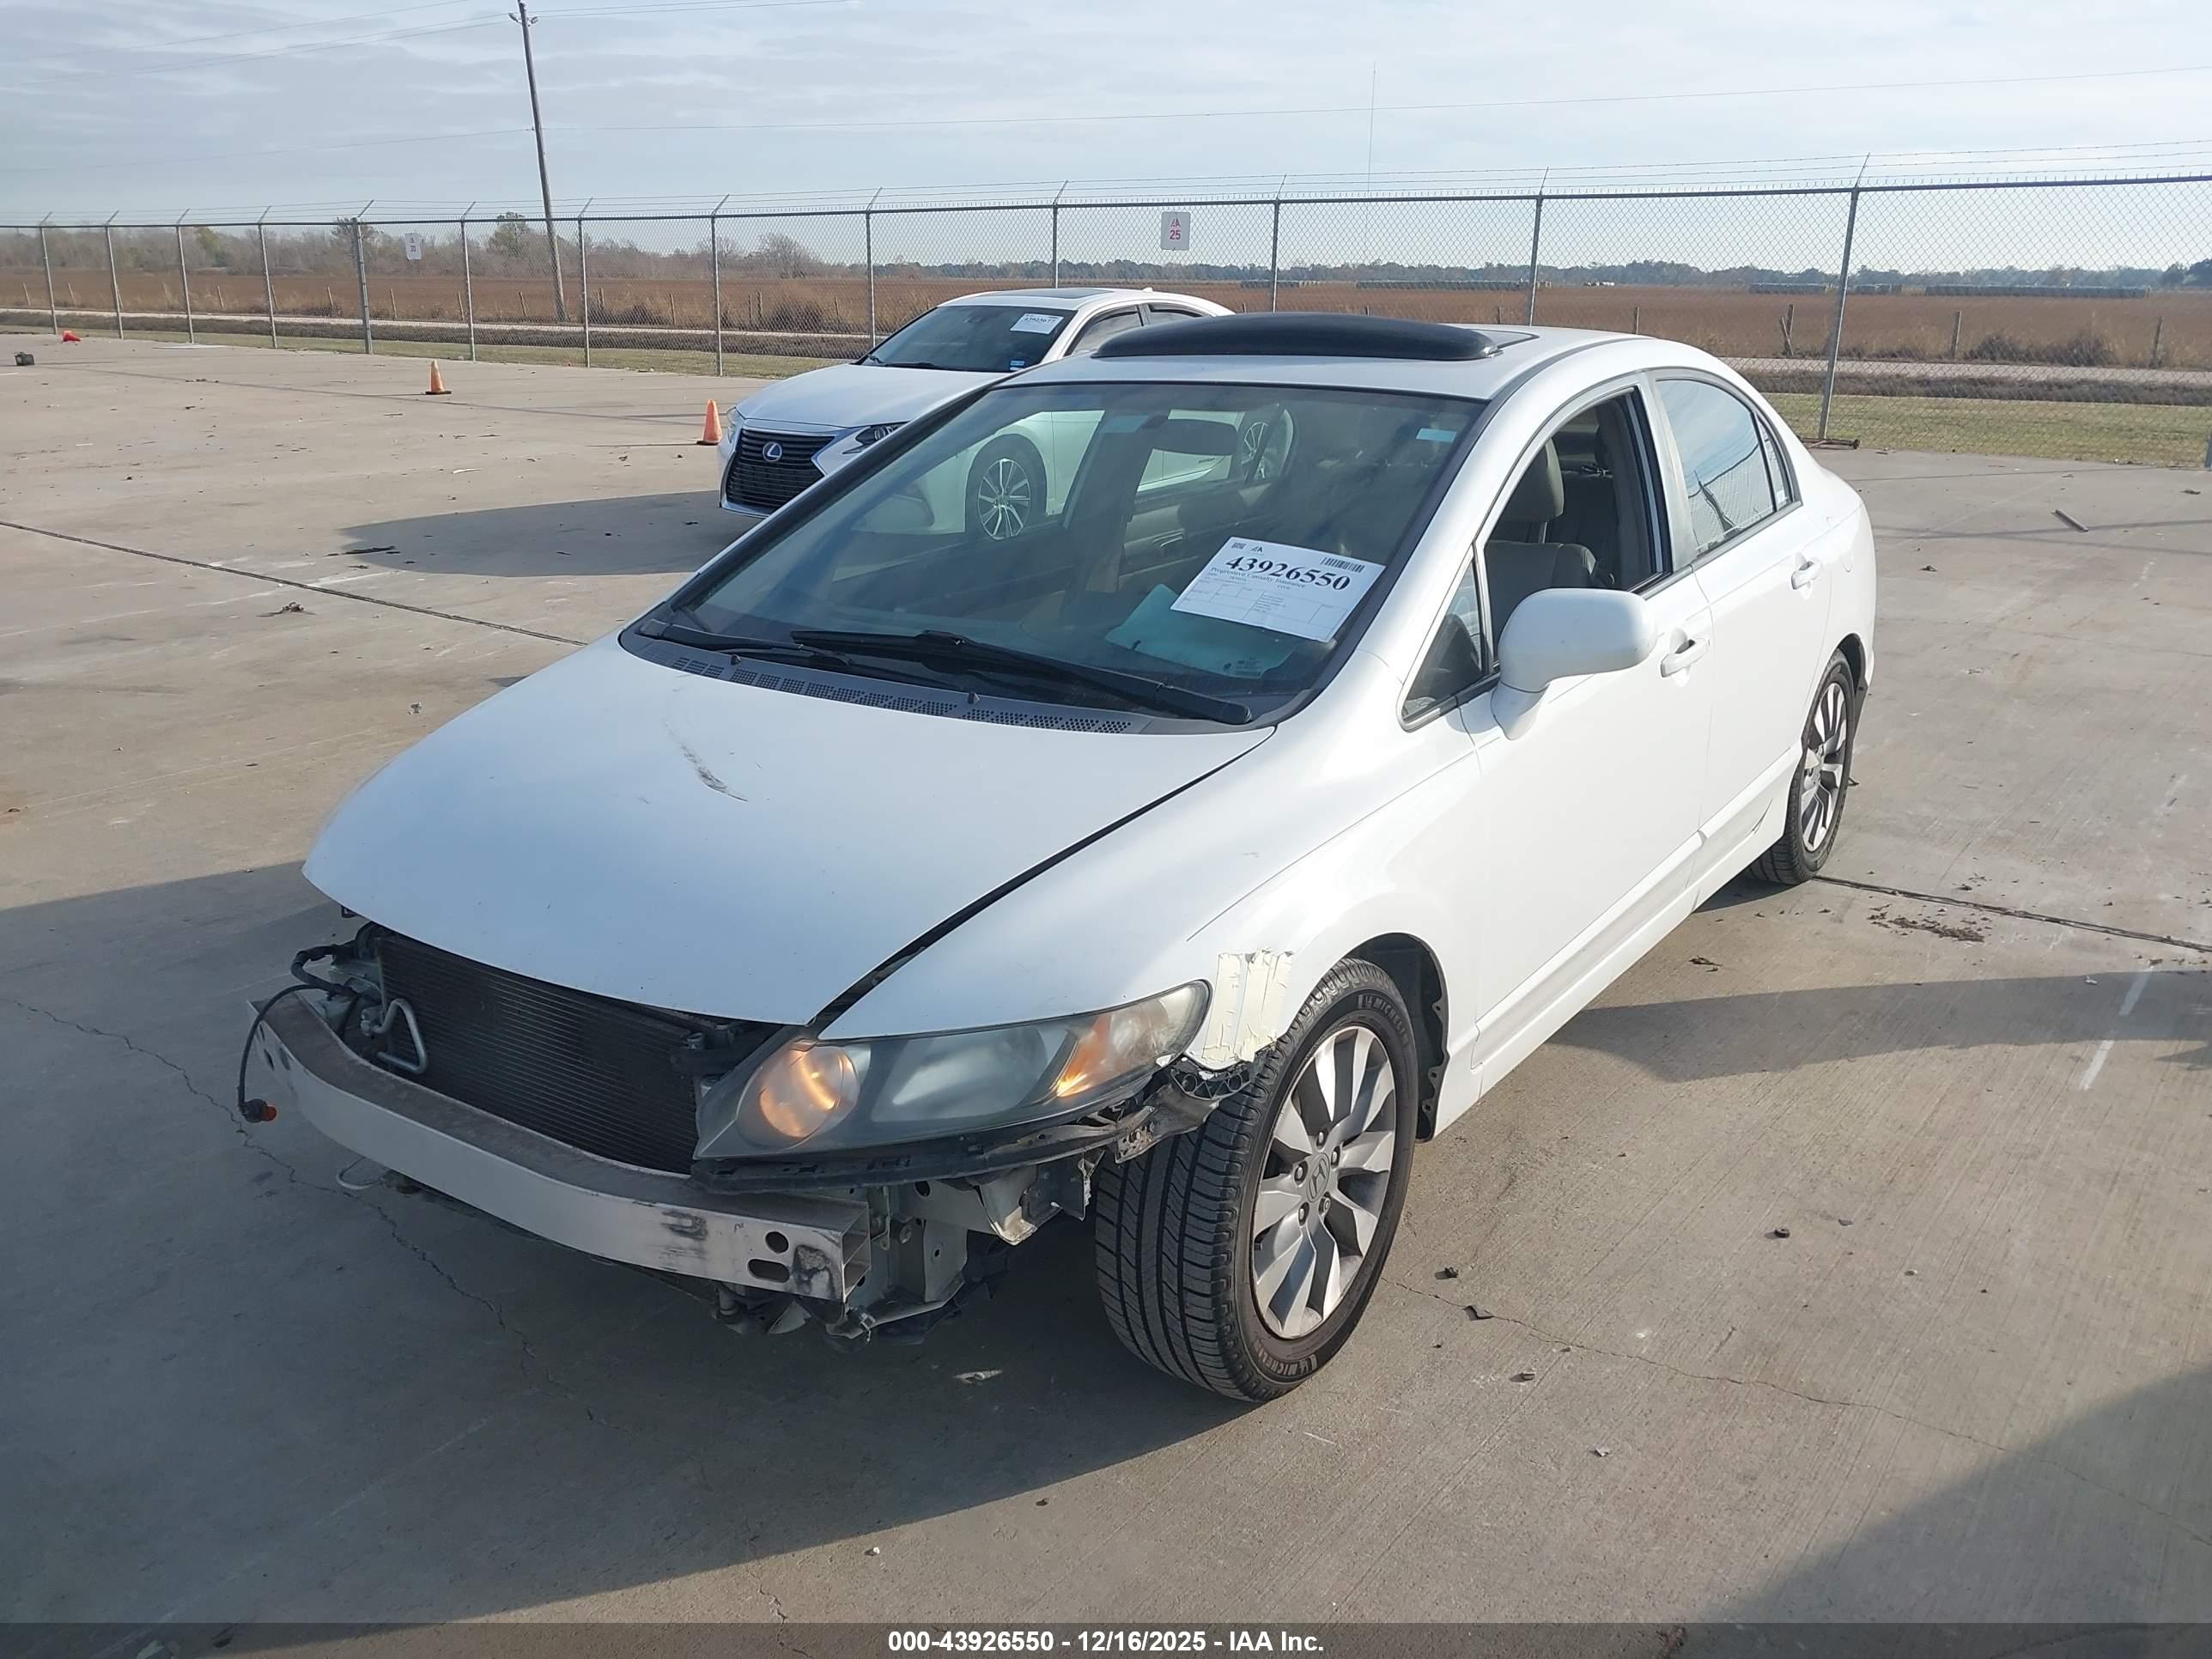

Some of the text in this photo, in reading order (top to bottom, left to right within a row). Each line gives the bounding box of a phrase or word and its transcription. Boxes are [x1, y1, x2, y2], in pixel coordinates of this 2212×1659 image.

[1170, 229, 1181, 240] 25
[1211, 567, 1247, 576] Progressive
[1247, 573, 1275, 582] Casualty
[1275, 579, 1306, 588] Insurance
[1225, 556, 1351, 591] 43926550
[1373, 998, 1409, 1045] MICHELIN
[1253, 1340, 1297, 1376] MICHELIN
